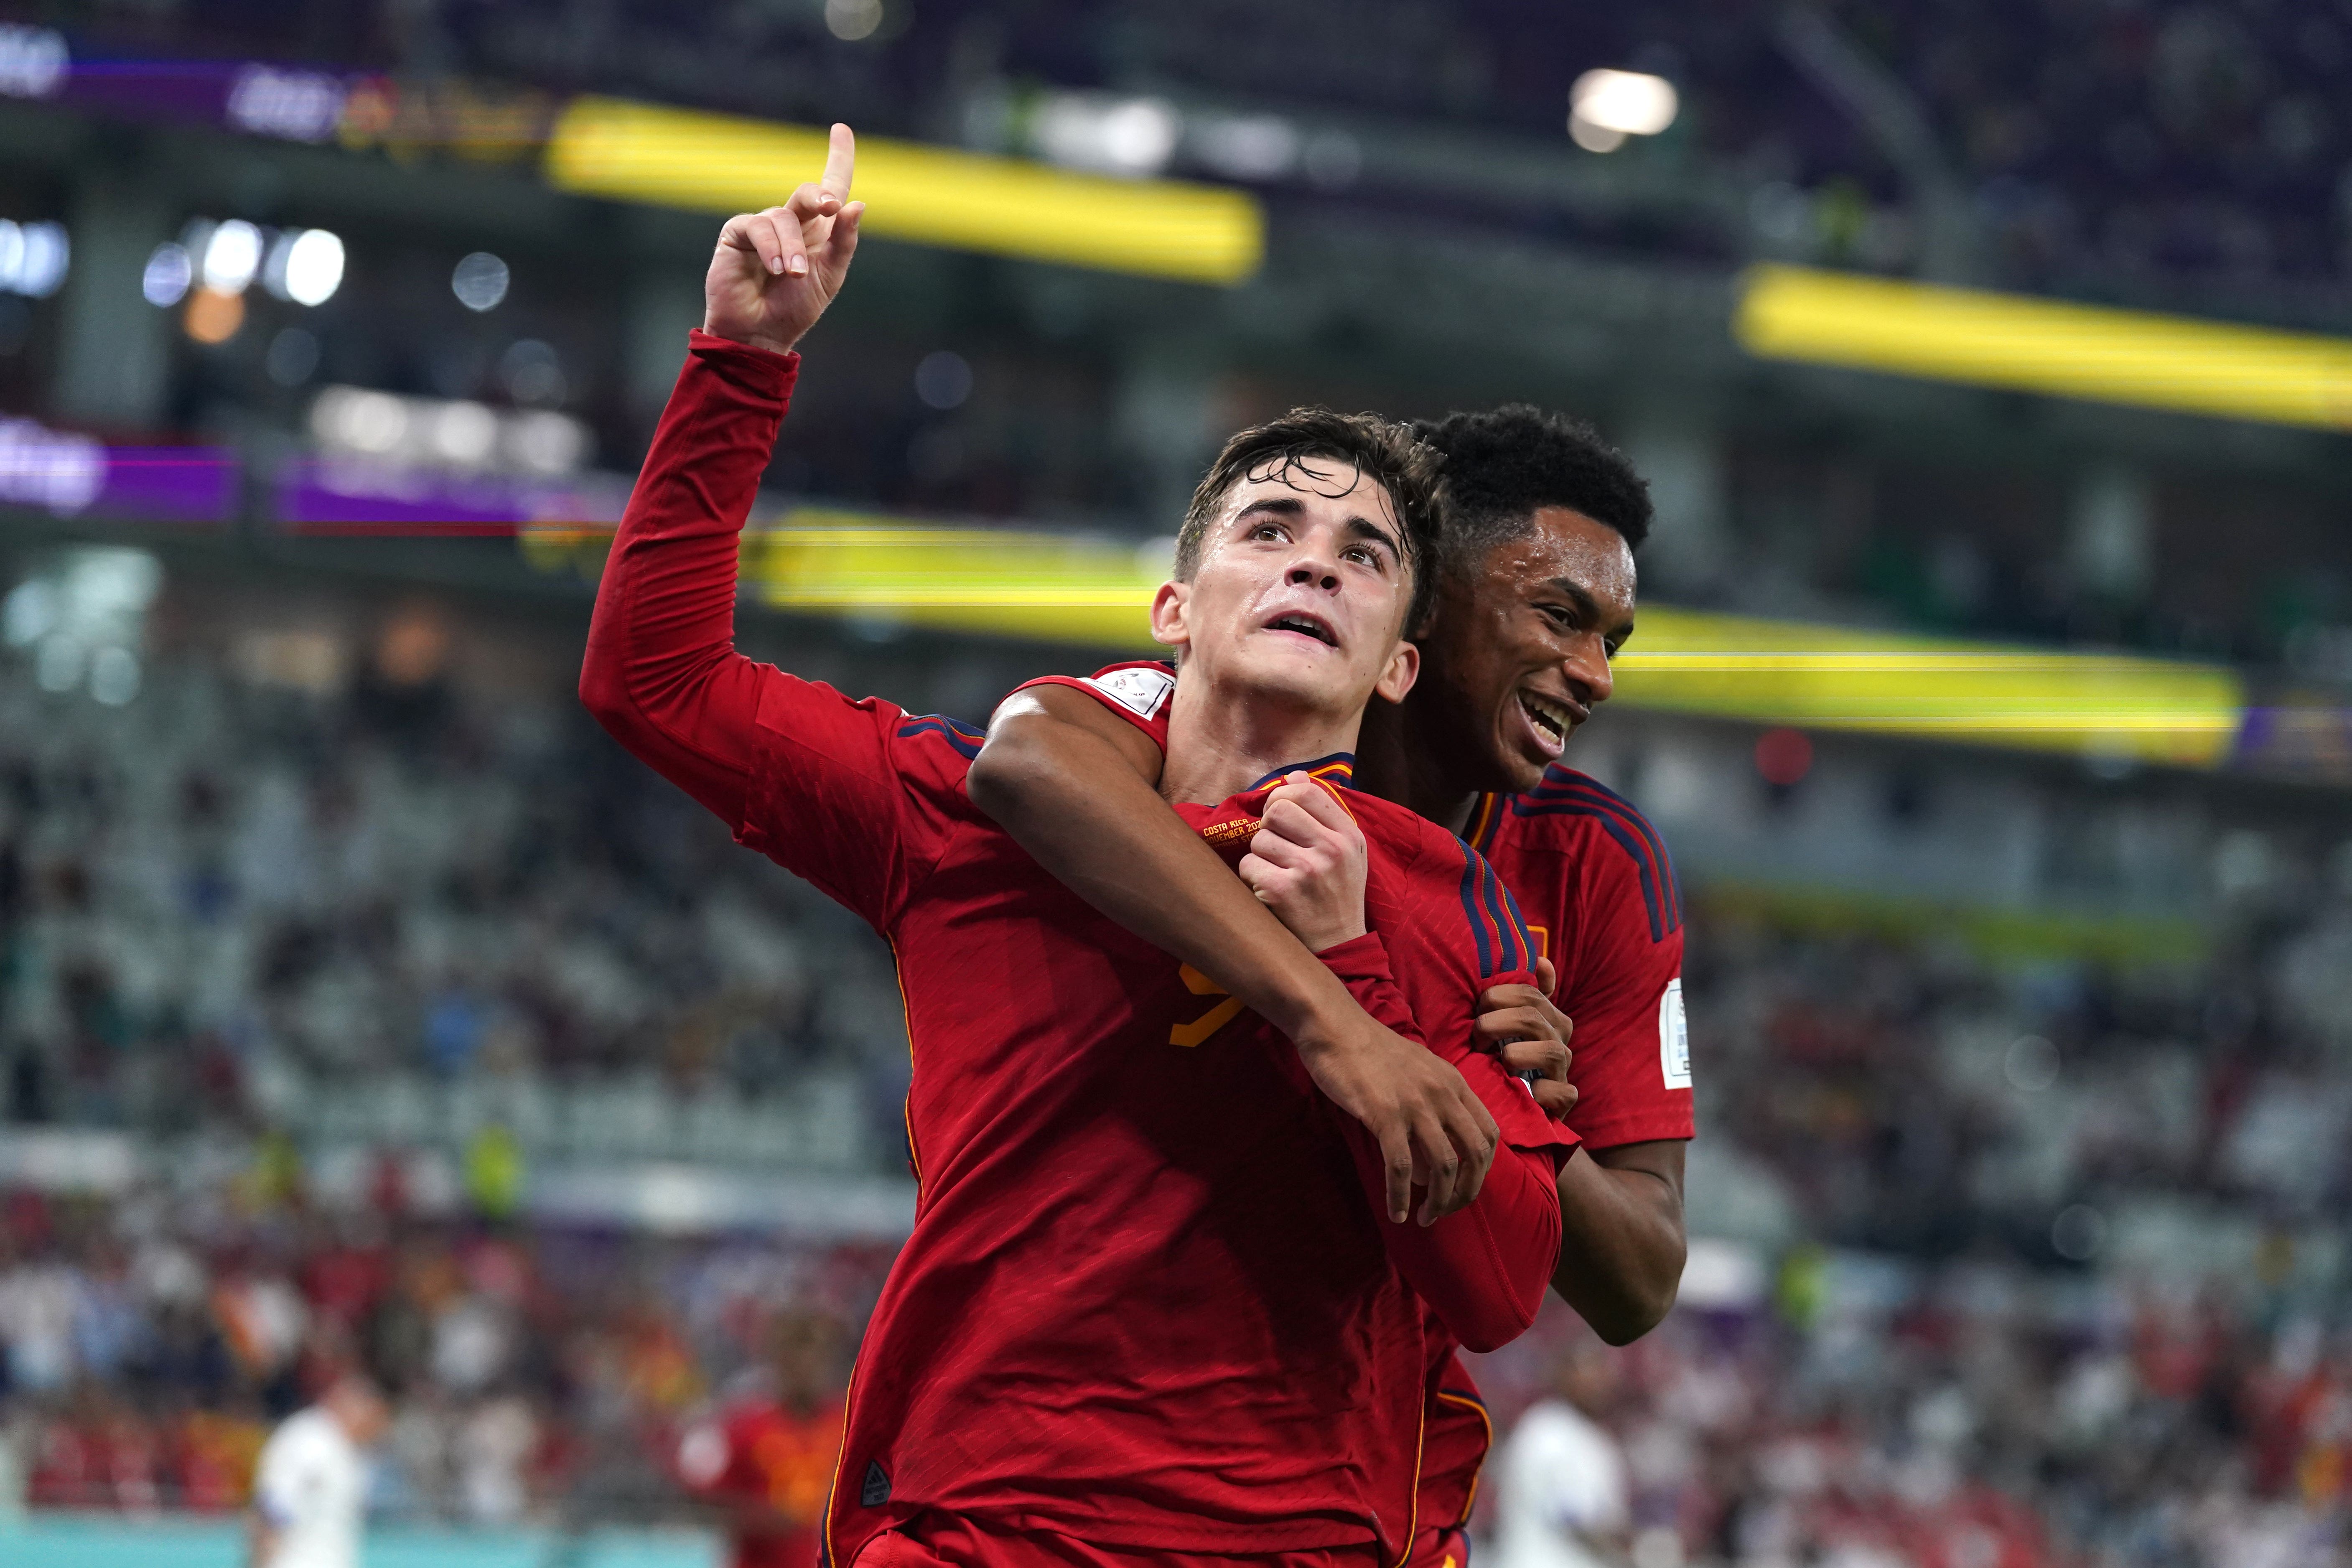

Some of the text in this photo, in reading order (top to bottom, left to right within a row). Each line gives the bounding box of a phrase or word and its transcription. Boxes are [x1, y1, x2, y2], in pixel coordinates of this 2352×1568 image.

[1203, 818, 1249, 837] COSTA RICA
[1245, 819, 1261, 832] 202
